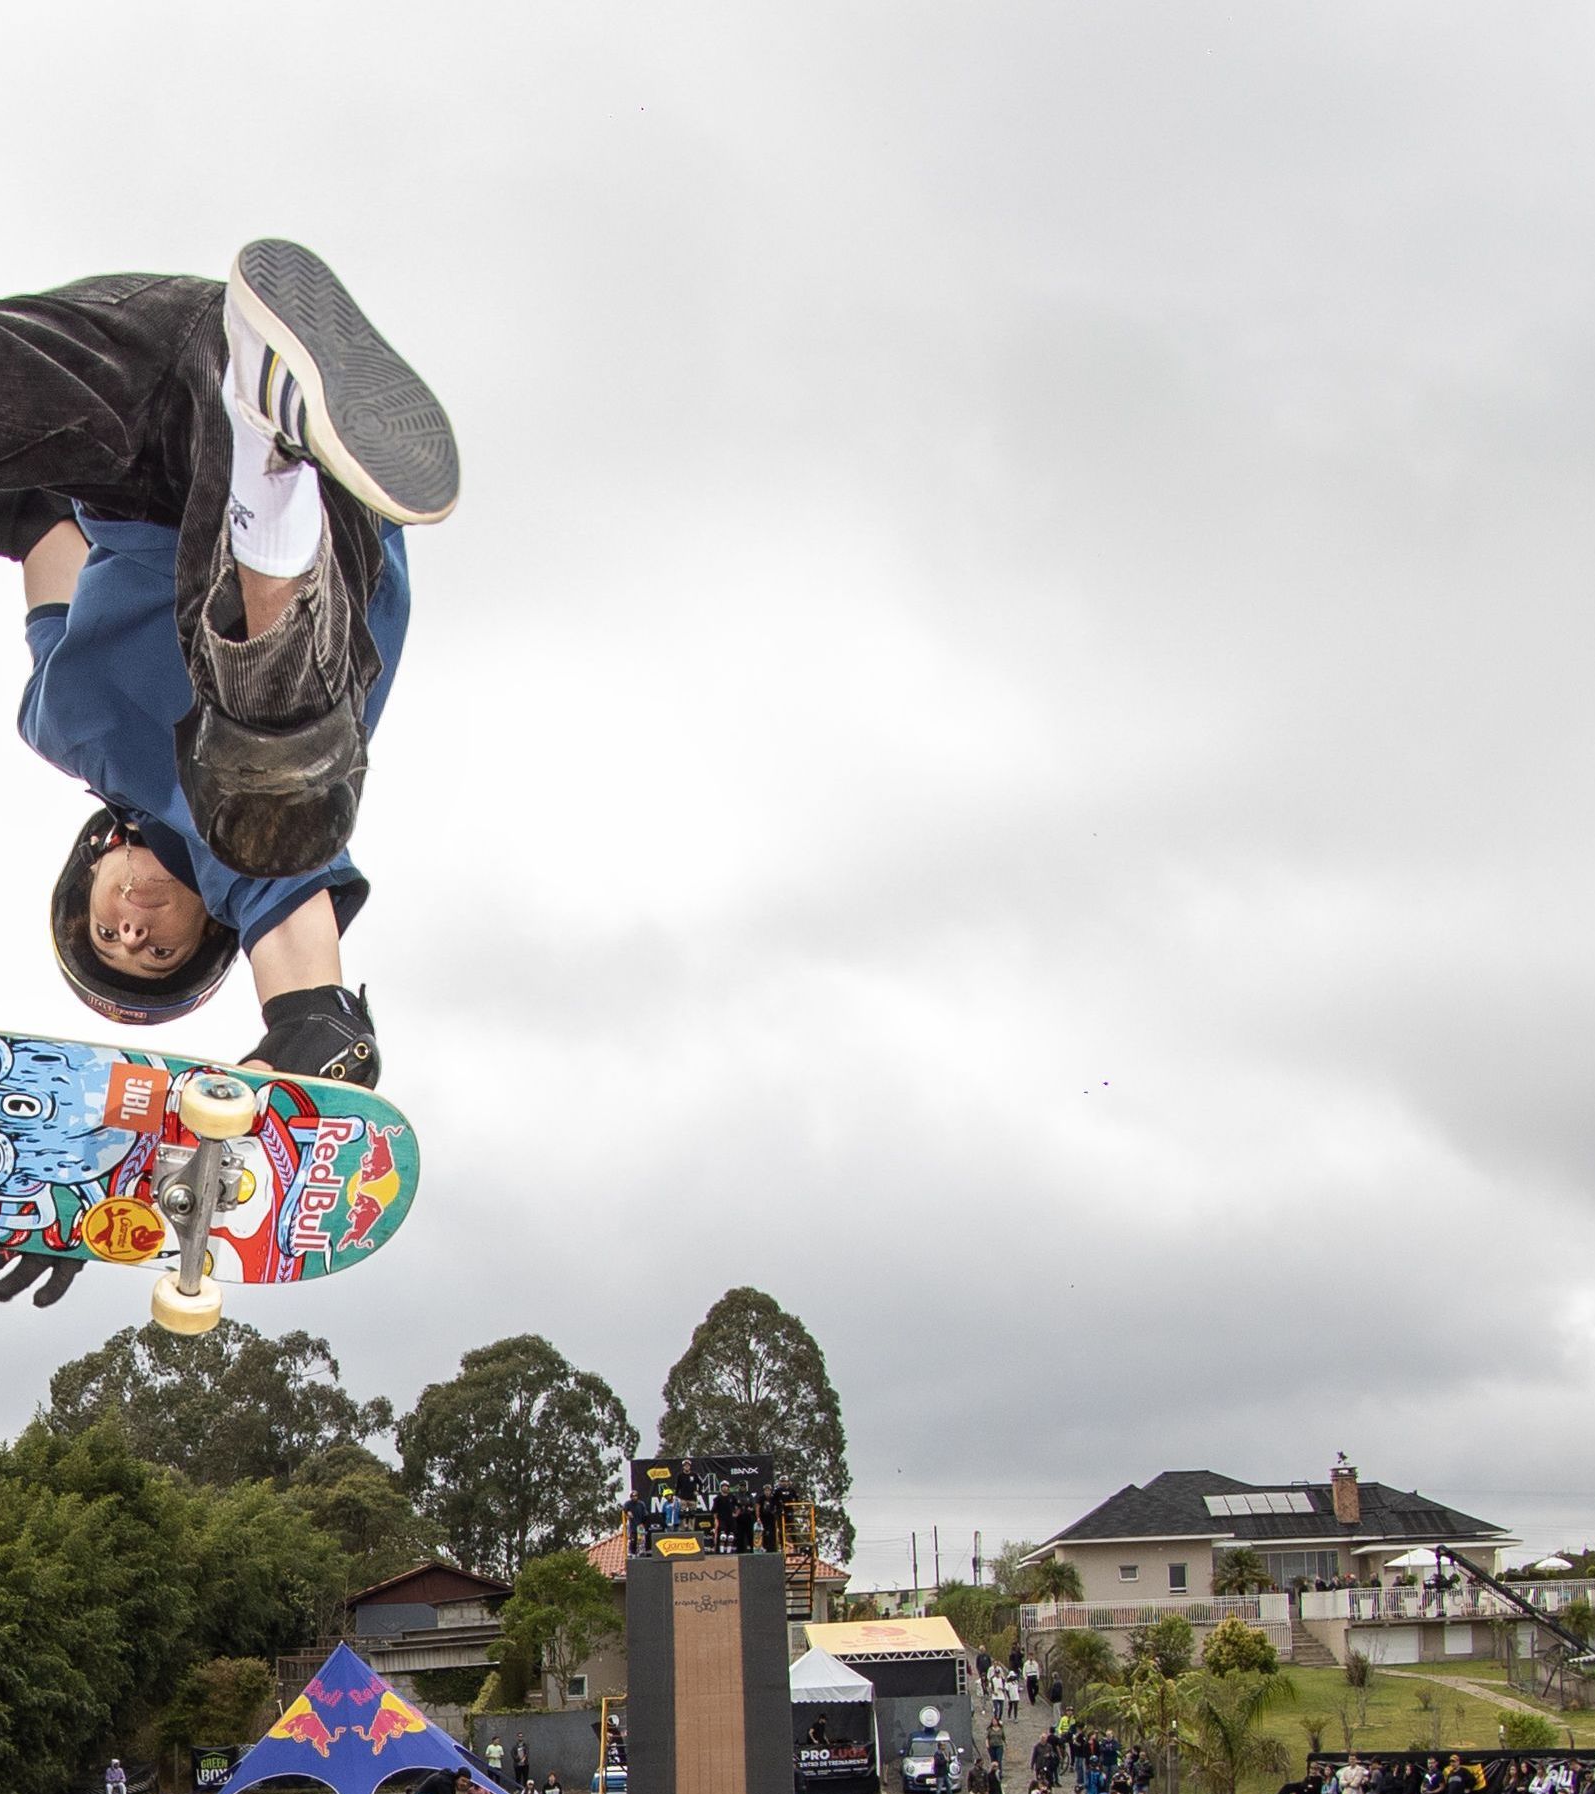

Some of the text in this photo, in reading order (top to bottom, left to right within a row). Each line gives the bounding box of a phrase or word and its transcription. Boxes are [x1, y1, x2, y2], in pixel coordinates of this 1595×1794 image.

[120, 1078, 153, 1121] JBL
[293, 1118, 356, 1252] Red Bull
[674, 1570, 737, 1583] EBANX
[201, 1758, 228, 1769] GREEN
